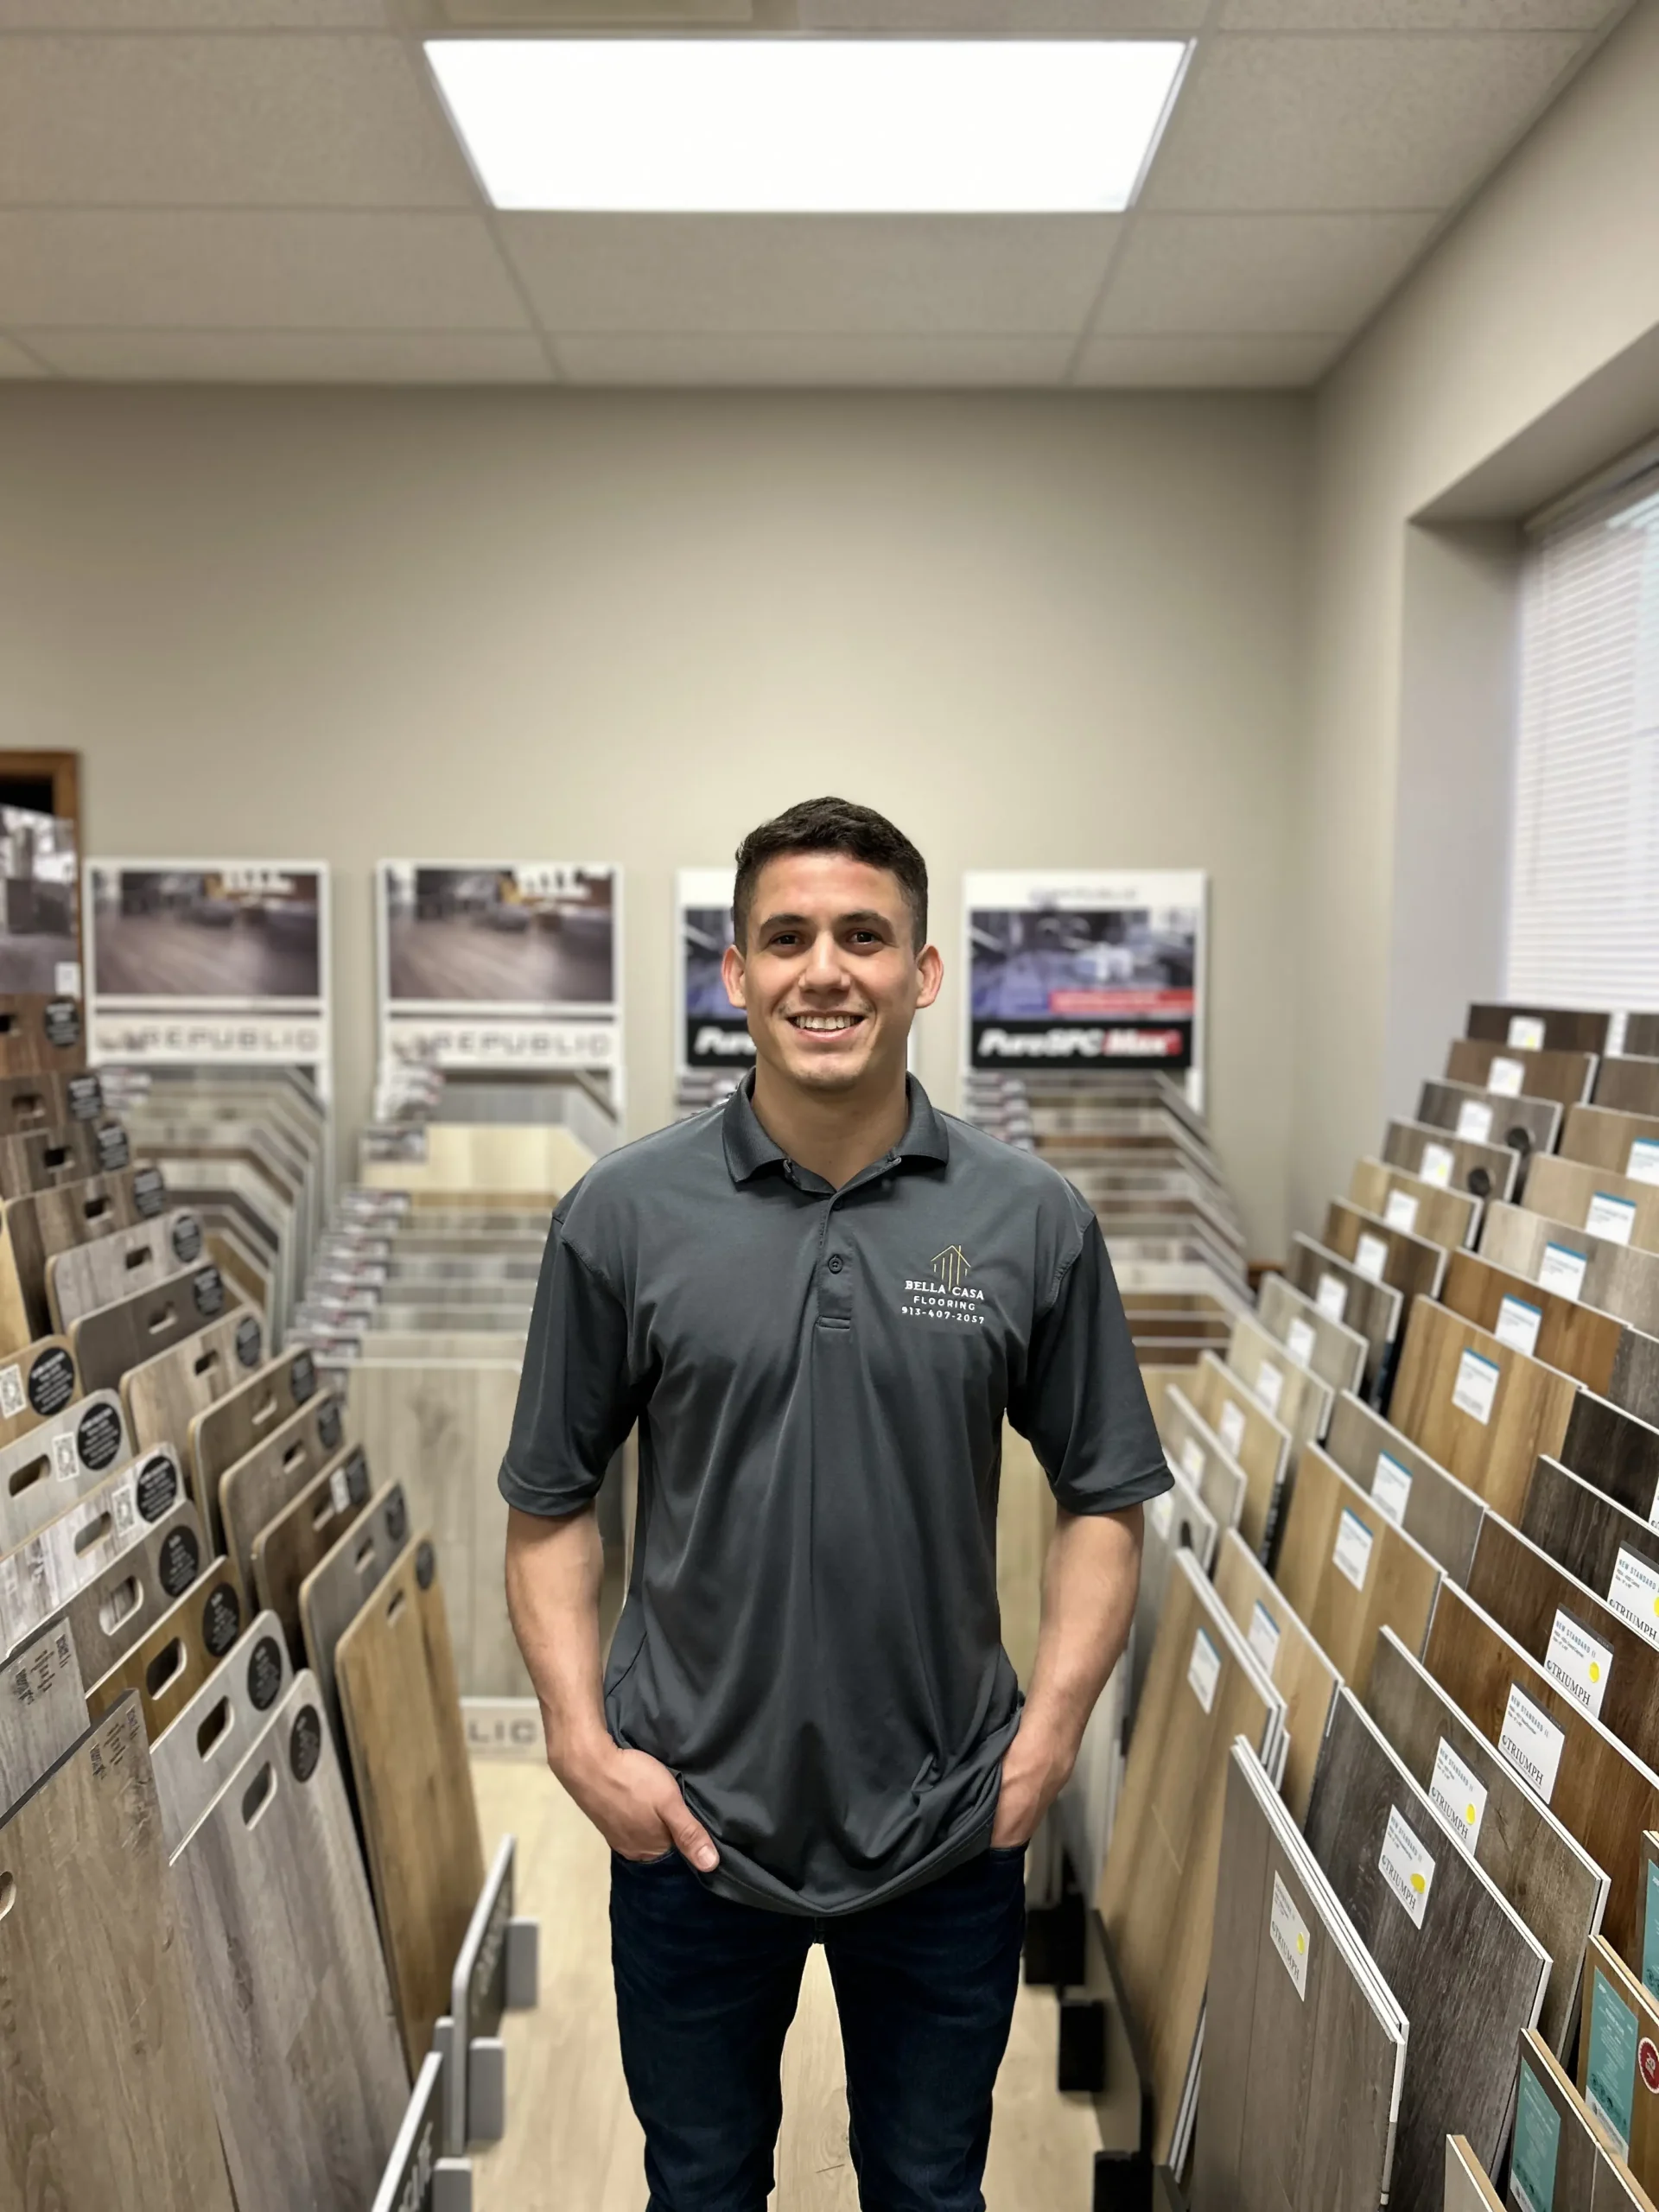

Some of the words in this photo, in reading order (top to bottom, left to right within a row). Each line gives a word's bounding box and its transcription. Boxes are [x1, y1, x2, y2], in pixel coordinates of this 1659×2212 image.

[905, 1281, 946, 1294] BELLA
[952, 1287, 984, 1300] CASA
[913, 1295, 976, 1311] FLOORING
[901, 1306, 985, 1325] 913-407-2057
[1618, 1559, 1630, 1571] NEW
[1630, 1566, 1656, 1590] STANDARD
[1556, 1620, 1566, 1632] NEW
[1567, 1629, 1590, 1654] STANDARD
[1614, 1600, 1657, 1640] TRIUMPH
[1552, 1662, 1592, 1706] TRIUMPH
[1521, 1705, 1544, 1732] STANDARD
[1506, 1738, 1544, 1786] TRIUMPH
[1435, 1789, 1469, 1839] TRIUMPH
[1385, 1858, 1416, 1910] TRIUMPH
